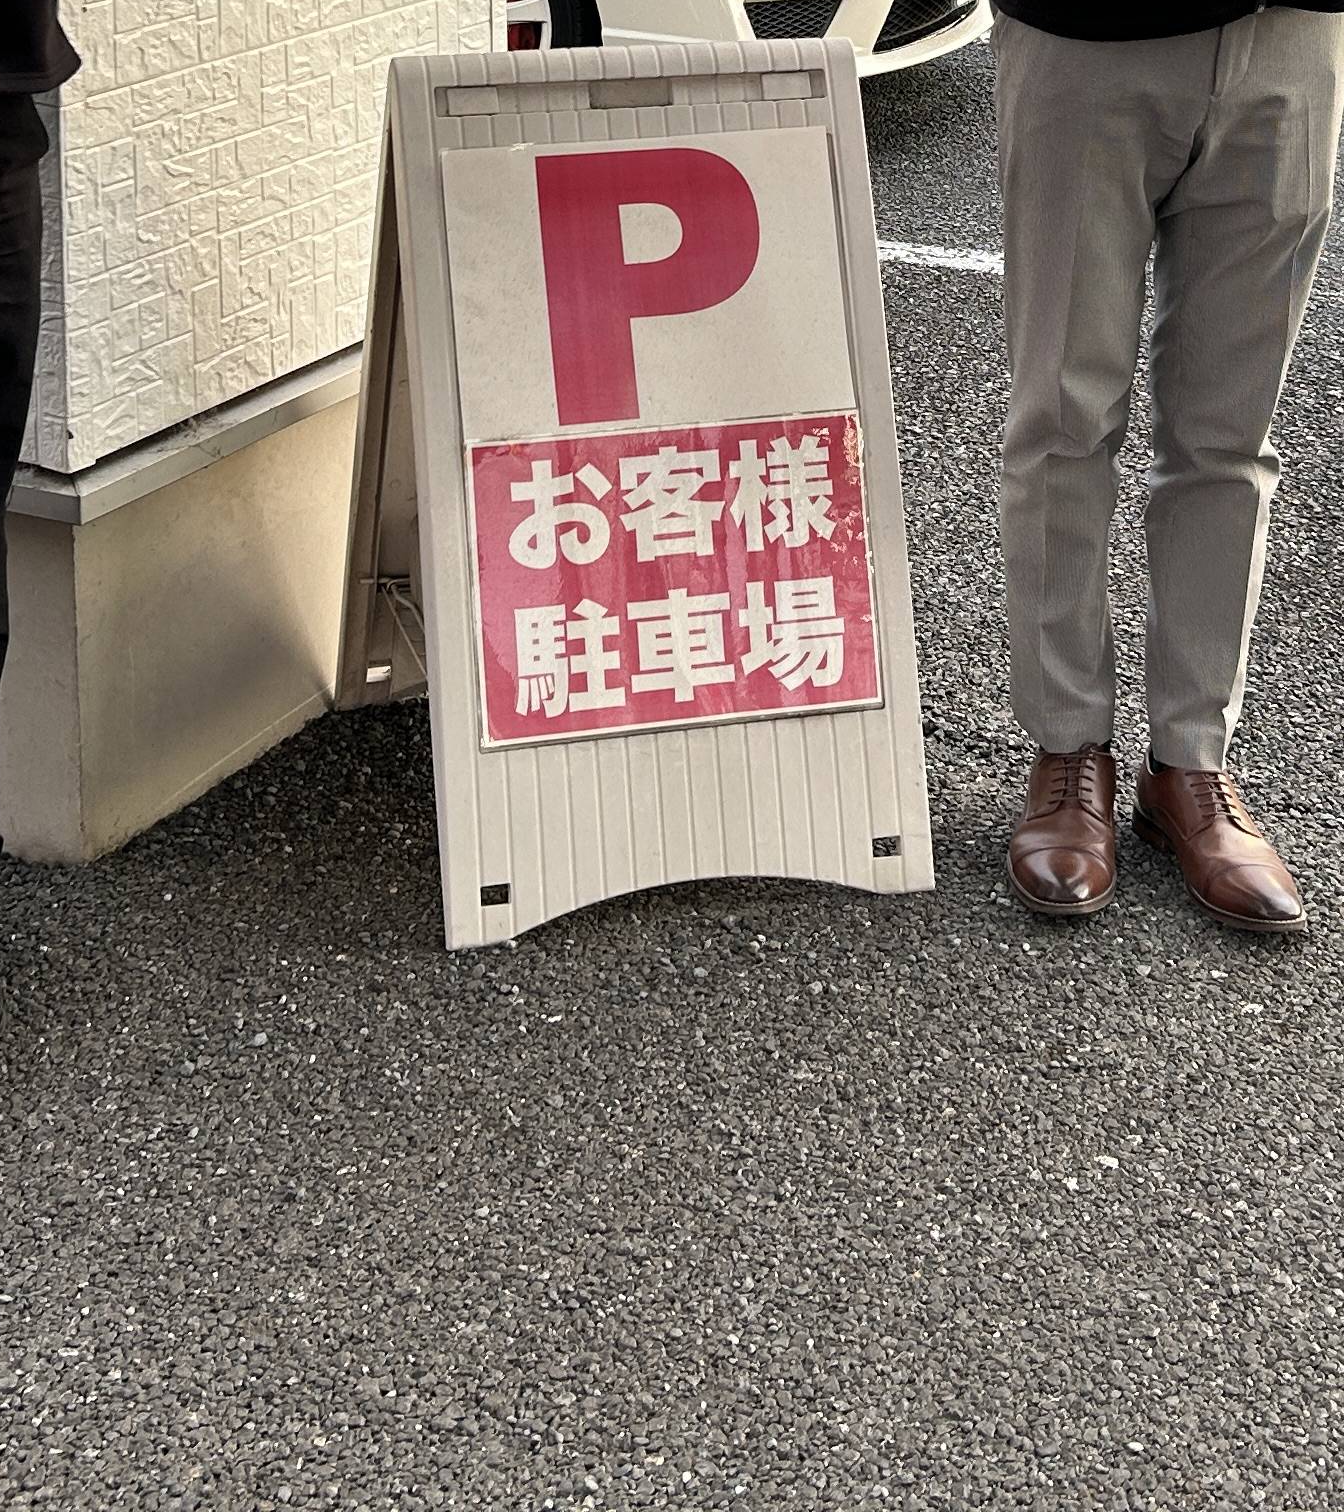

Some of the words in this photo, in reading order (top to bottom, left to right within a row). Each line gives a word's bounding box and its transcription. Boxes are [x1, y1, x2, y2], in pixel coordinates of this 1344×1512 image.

[535, 148, 760, 426] P
[508, 435, 837, 569] お客様
[514, 576, 845, 718] 駐車場
